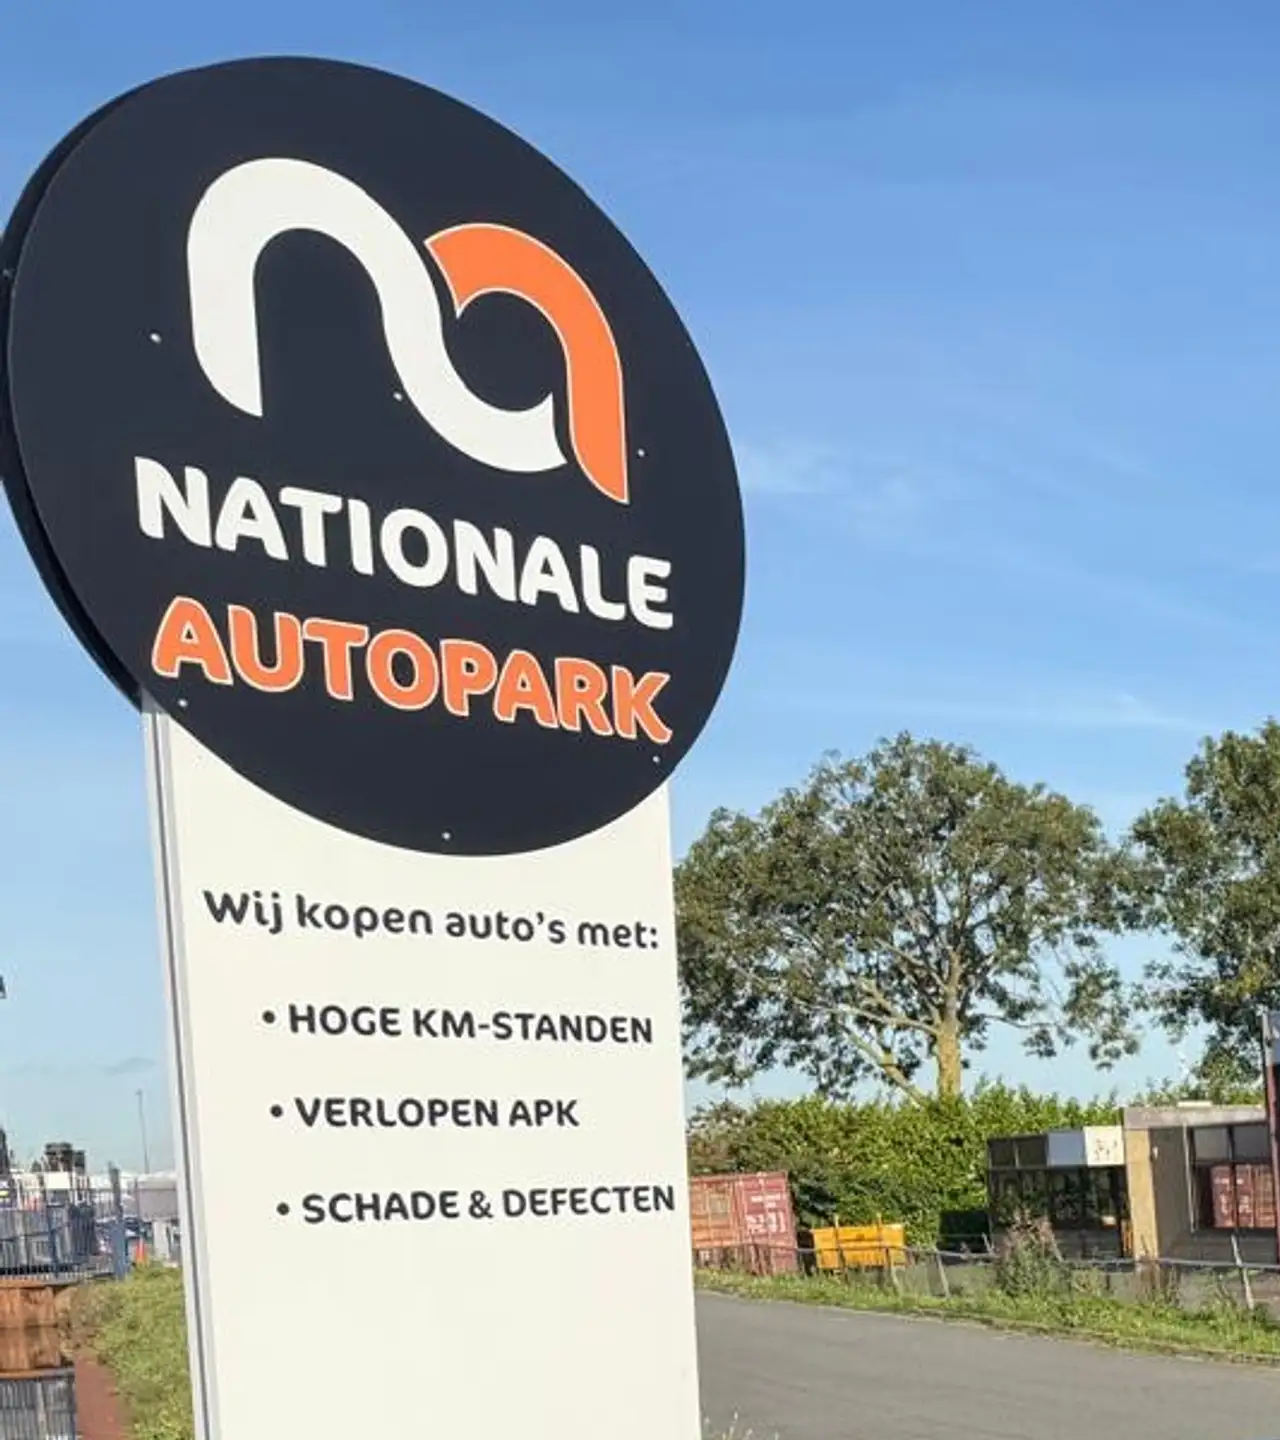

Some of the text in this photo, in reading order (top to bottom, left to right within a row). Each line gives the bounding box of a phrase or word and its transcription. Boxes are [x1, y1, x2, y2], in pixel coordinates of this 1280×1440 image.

[134, 456, 674, 629] NATIONALE
[151, 596, 673, 745] AUTOPARK
[203, 890, 661, 949] Wij kopen auto’s met:
[288, 1004, 652, 1044] HOGE KM-STANDEN
[295, 1097, 579, 1127] VERLOPEN APK
[302, 1185, 675, 1224] SCHADE & DEFECTEN
